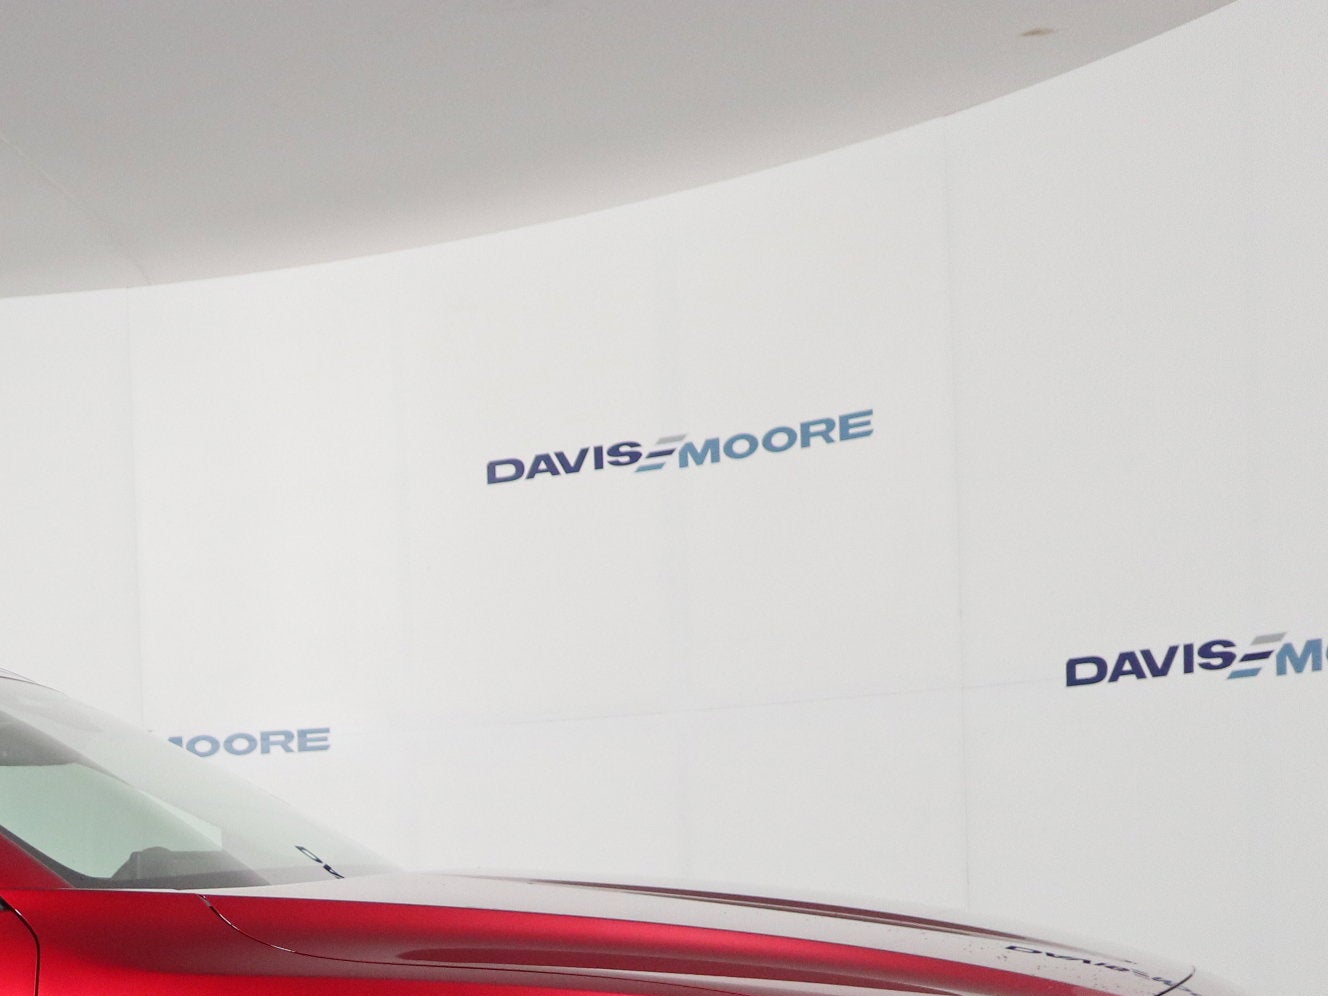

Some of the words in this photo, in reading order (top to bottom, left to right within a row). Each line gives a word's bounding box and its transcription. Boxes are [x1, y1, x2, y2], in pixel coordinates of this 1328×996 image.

[485, 441, 642, 485] DAVIS
[677, 409, 874, 468] MOORE
[1065, 639, 1237, 687] DAVIS
